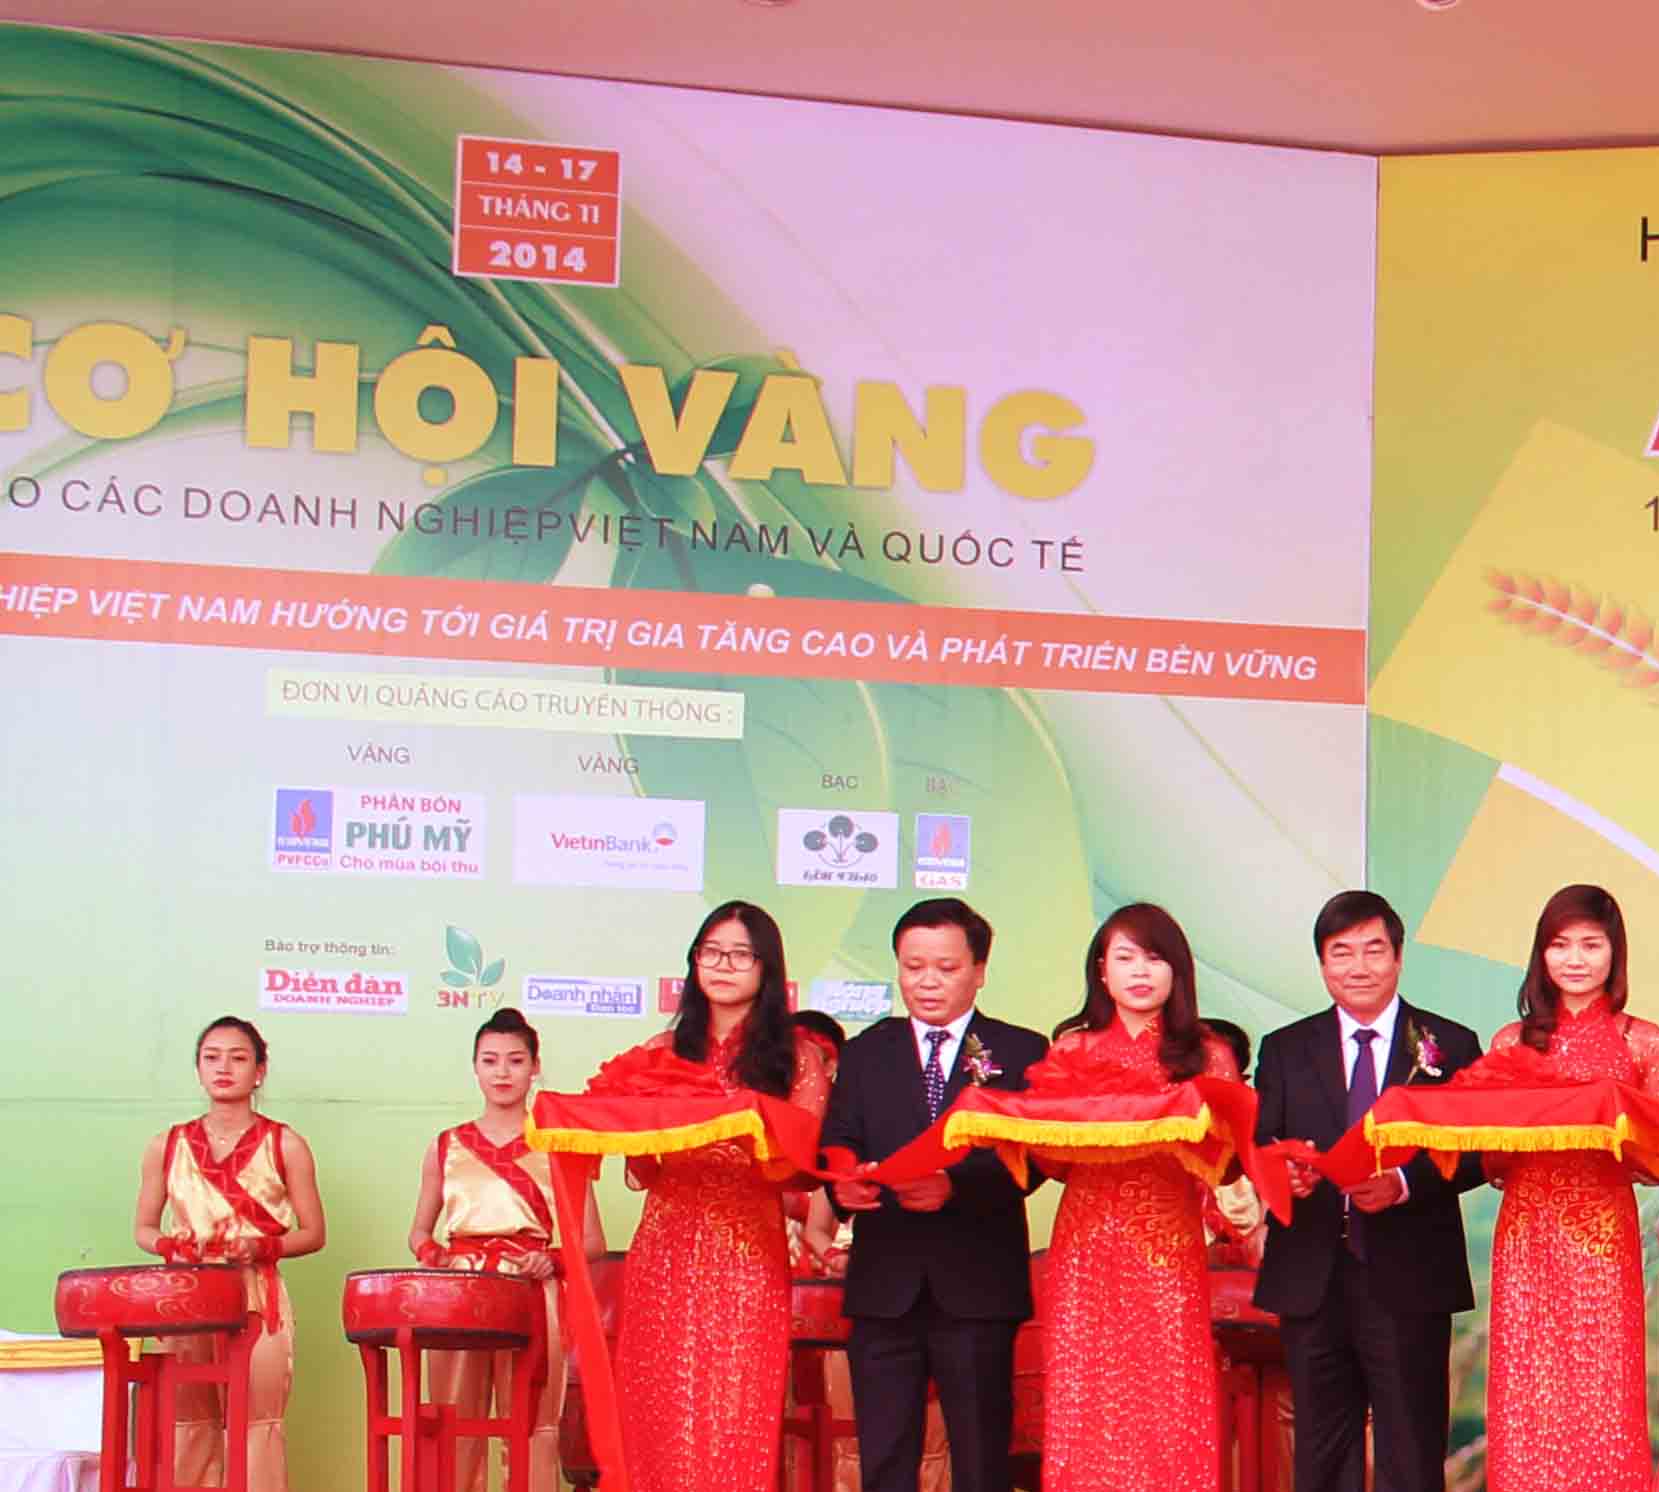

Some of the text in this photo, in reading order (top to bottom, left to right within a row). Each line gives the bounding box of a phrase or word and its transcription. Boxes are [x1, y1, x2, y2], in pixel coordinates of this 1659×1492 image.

[487, 152, 523, 175] 14
[560, 158, 598, 181] 17
[477, 193, 600, 224] THÁNG 11
[489, 240, 587, 272] 2014
[245, 325, 560, 487] HỘI
[617, 350, 1096, 502] VÀNG
[61, 475, 163, 517] CÁC
[183, 487, 358, 529] DOANH
[690, 518, 790, 556] NAM
[805, 521, 865, 560] VÀ
[882, 529, 1015, 568] QUỐC
[1032, 536, 1084, 572] TẾ
[88, 588, 171, 625] VIỆT
[178, 596, 262, 625] NAM
[270, 598, 409, 634] HƯỚNG
[420, 605, 481, 638] TỚI
[489, 610, 551, 642] GIÁ
[563, 617, 618, 651] TRỊ
[627, 620, 685, 649] GIA
[697, 619, 790, 655] TĂNG
[800, 629, 875, 658] CAO
[887, 629, 929, 662] VÀ
[940, 633, 1031, 667] PHÁT
[1039, 640, 1137, 673] TRIỂN
[1145, 642, 1214, 676] BỀN
[1223, 647, 1317, 682] VỮNG
[281, 679, 342, 703] ĐƠN
[475, 685, 528, 713] CÁO
[347, 743, 411, 766] VÀNG
[577, 753, 640, 776] VÀNG
[346, 816, 472, 853] PHÚ MỸ
